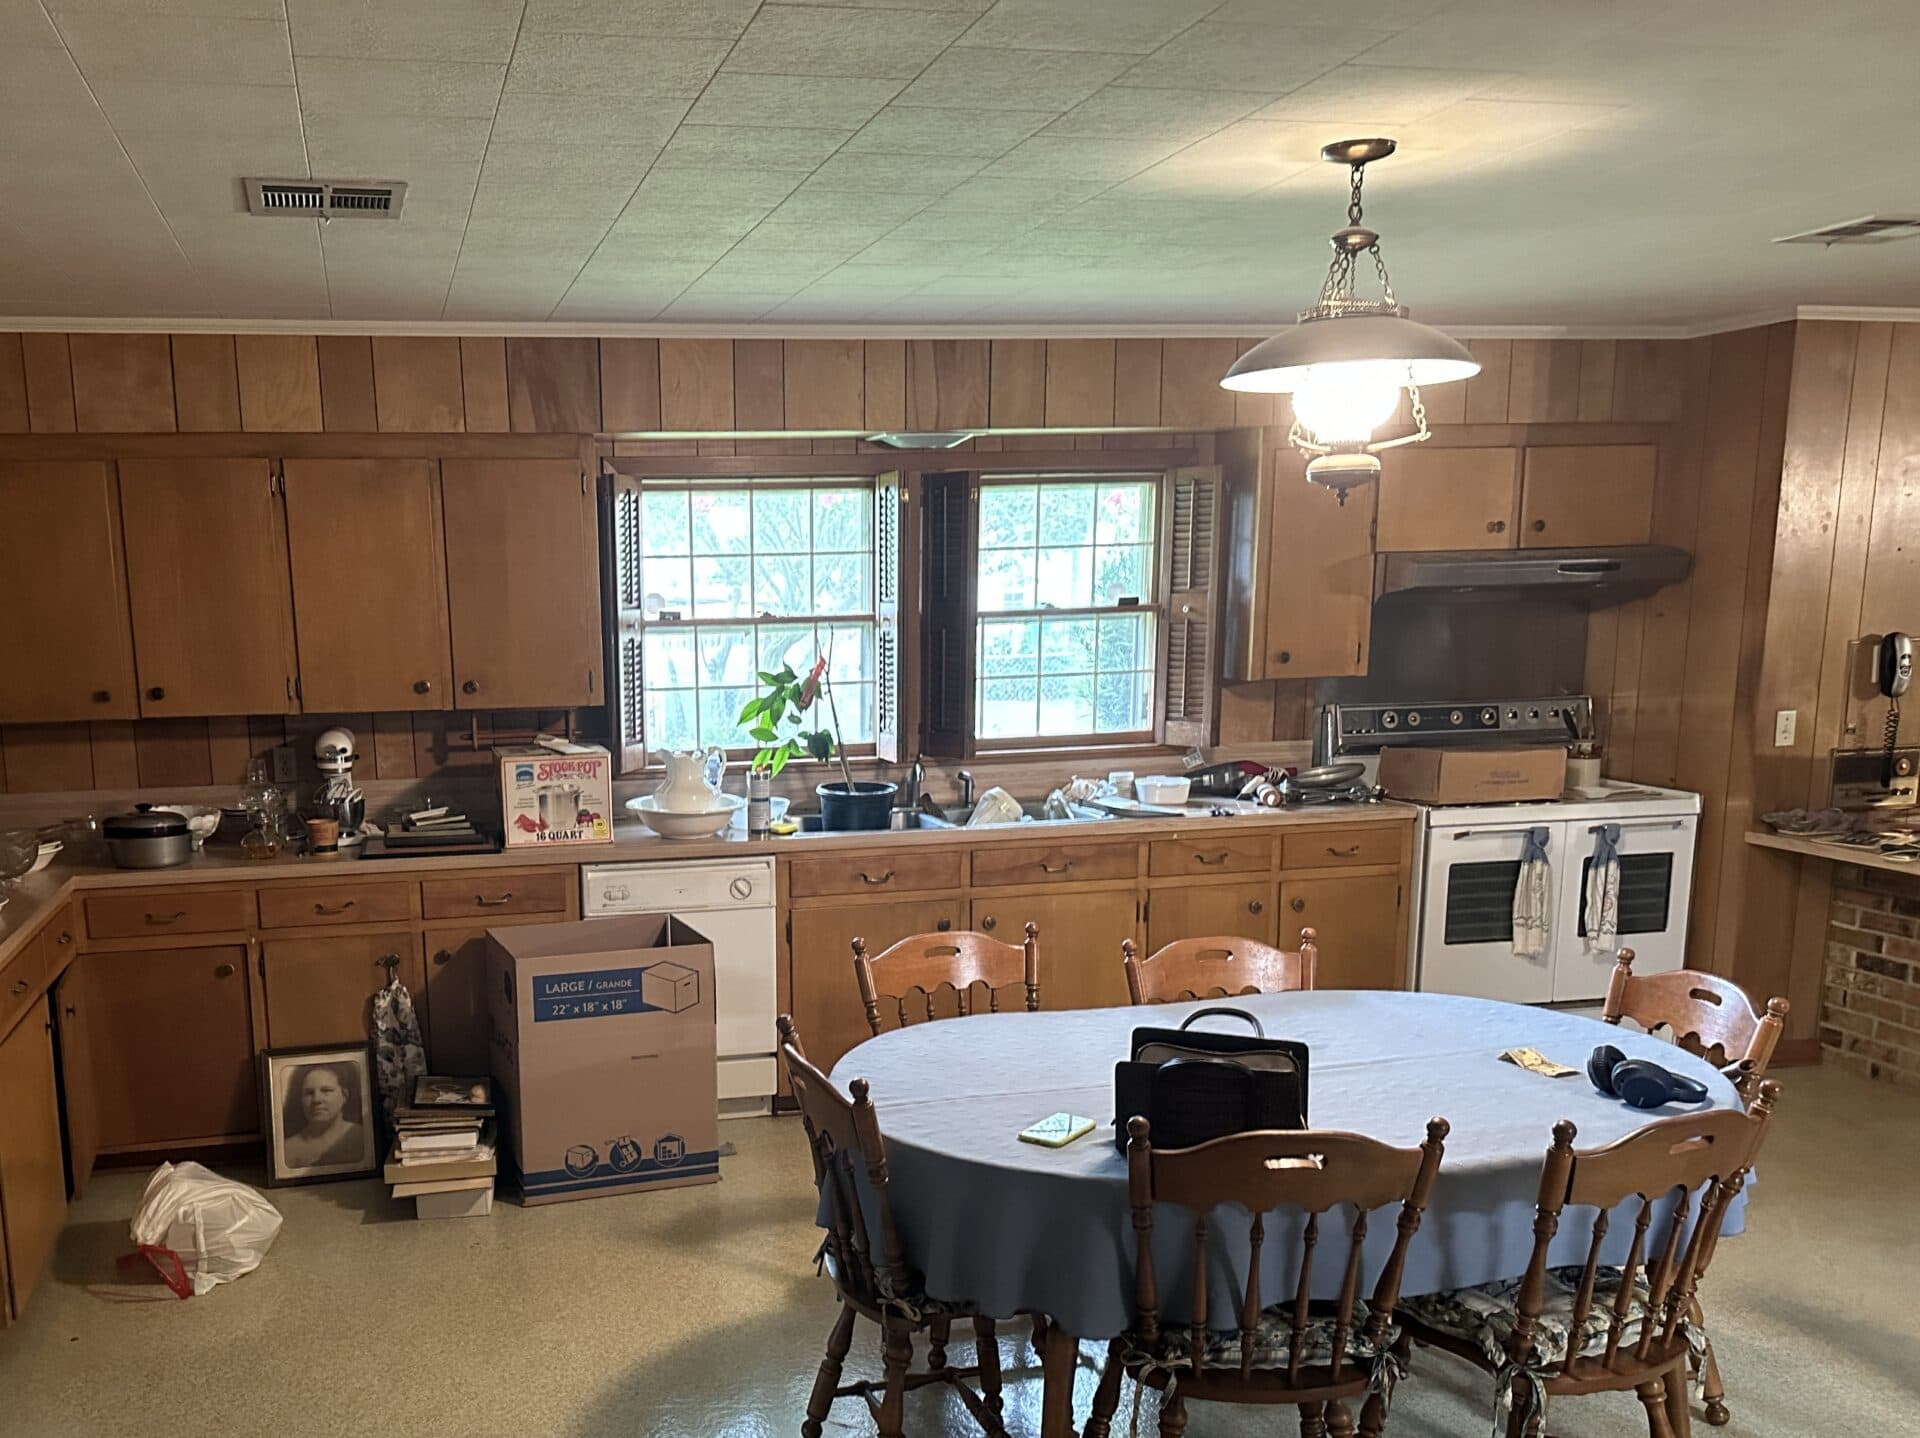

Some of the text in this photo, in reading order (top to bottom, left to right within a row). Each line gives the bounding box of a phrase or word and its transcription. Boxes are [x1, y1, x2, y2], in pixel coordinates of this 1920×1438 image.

[536, 830, 584, 841] 16 QUART
[545, 981, 585, 994] LARGE
[596, 979, 633, 990] GRANDE
